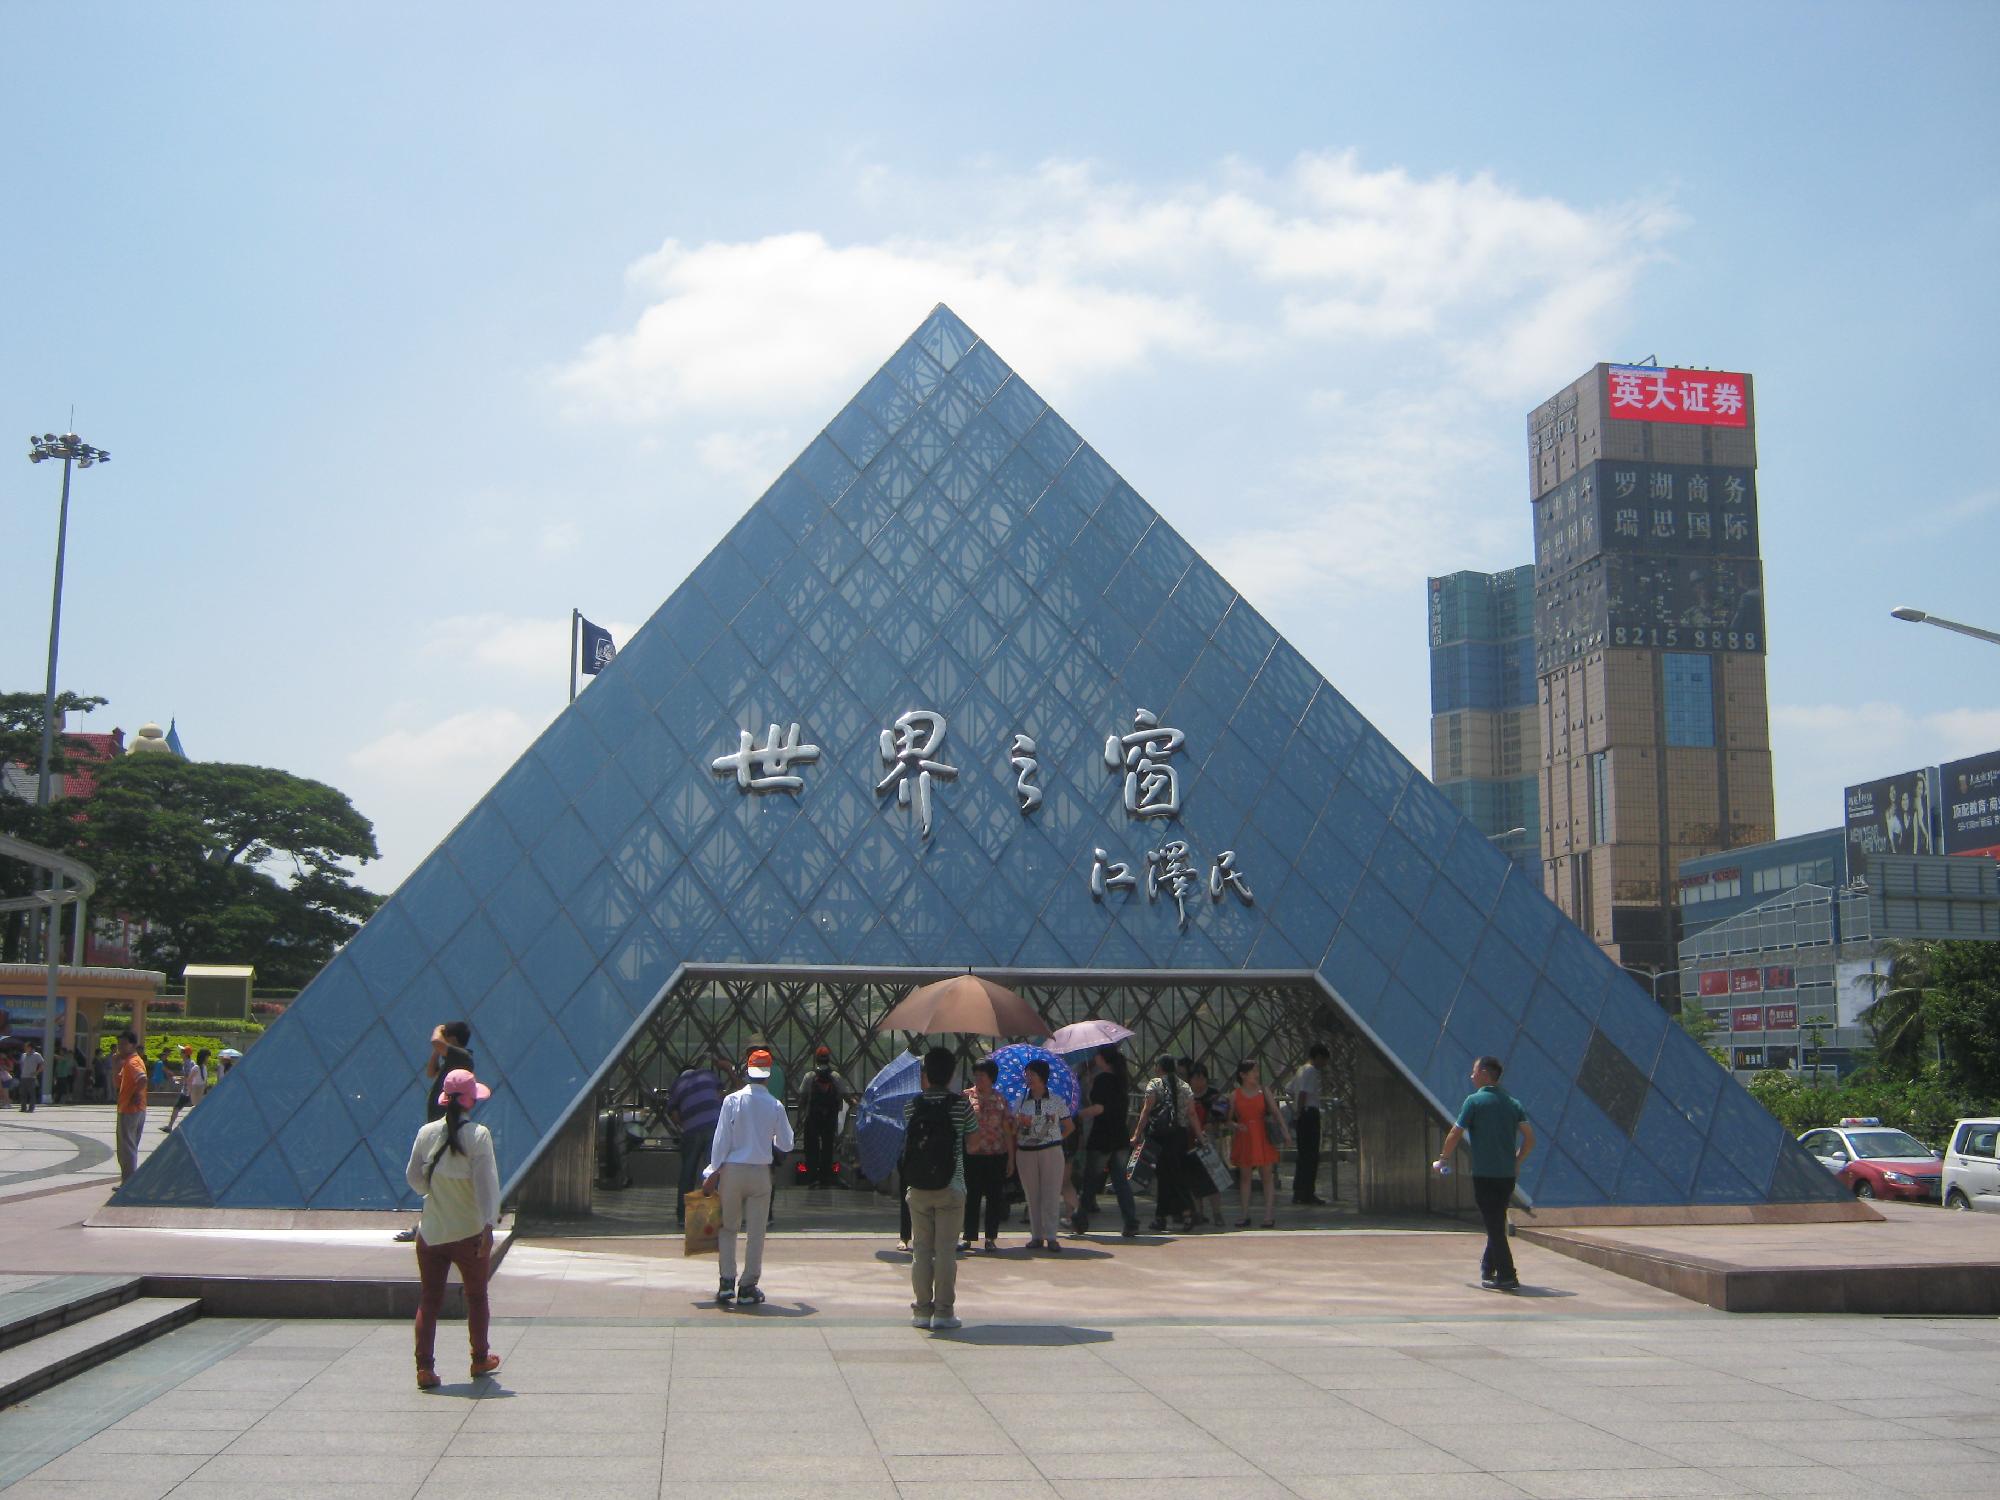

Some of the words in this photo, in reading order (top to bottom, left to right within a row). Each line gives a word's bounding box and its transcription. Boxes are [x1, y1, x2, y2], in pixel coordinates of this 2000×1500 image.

[1612, 374, 1742, 415] 英大证券
[1615, 471, 1746, 504] 罗湖商务
[1614, 508, 1748, 540] 瑞思国际
[1615, 626, 1679, 647] 8215
[1694, 630, 1756, 650] 8888
[711, 708, 1186, 839] 世界之窗
